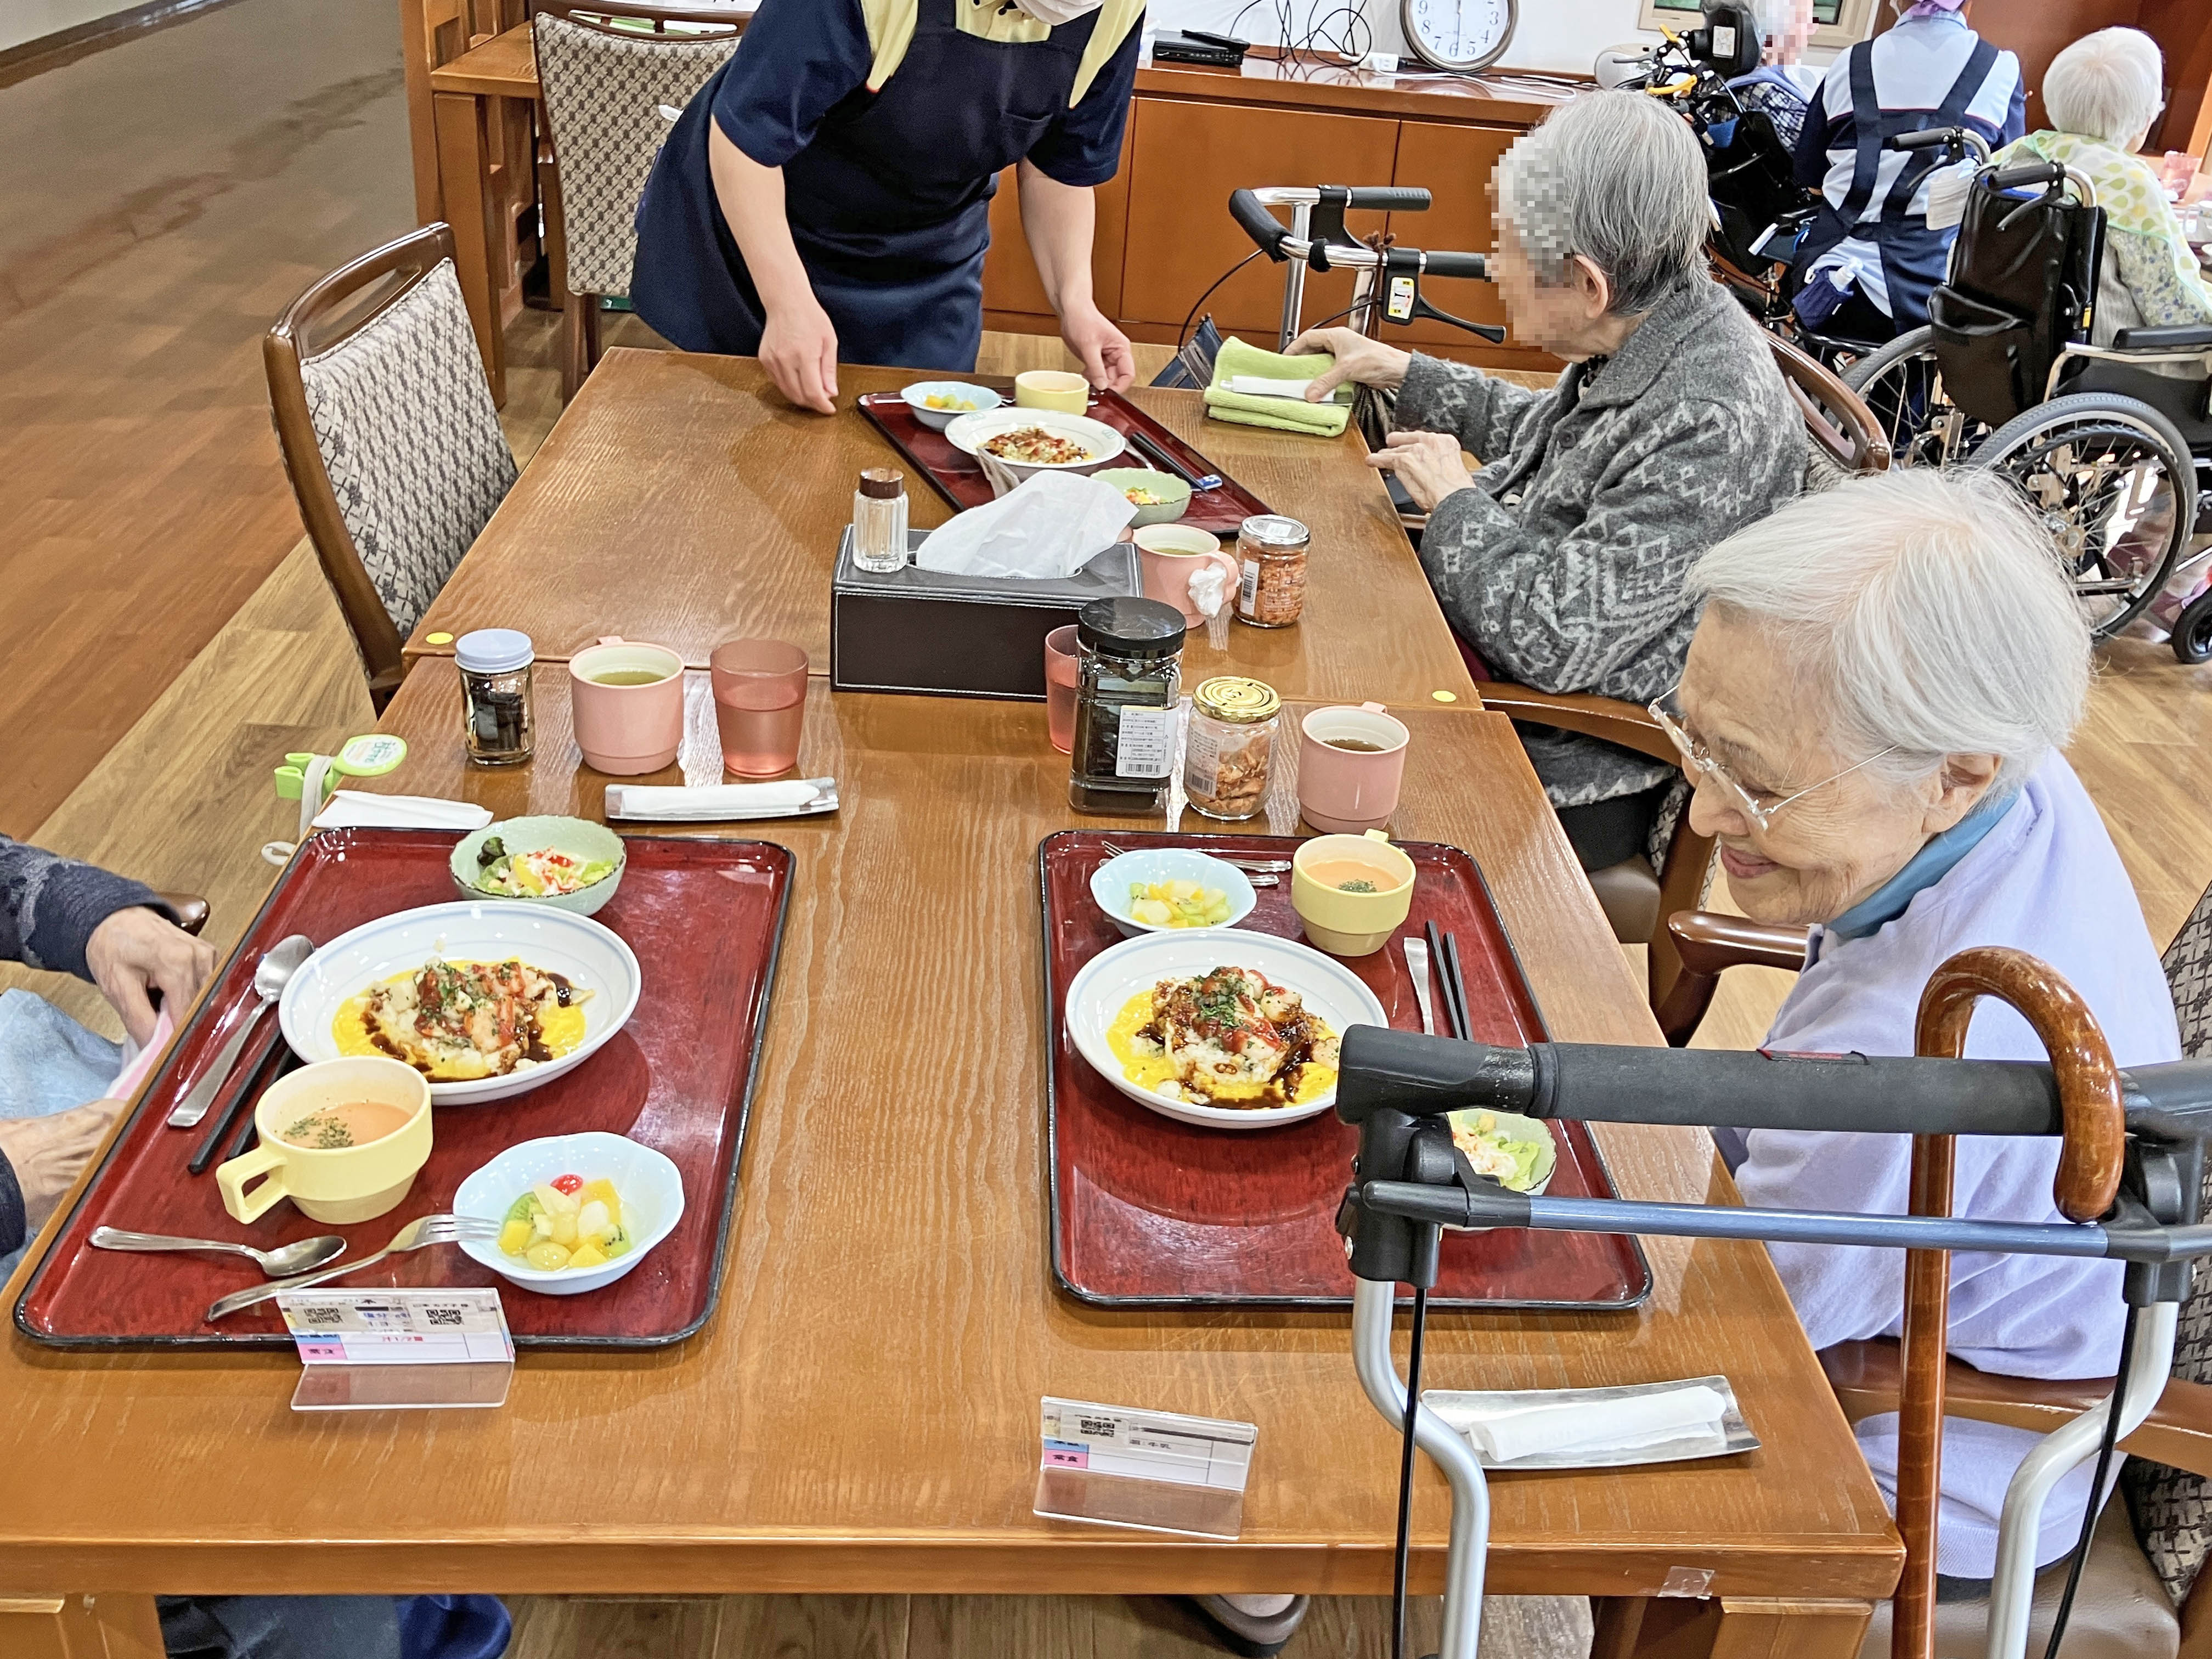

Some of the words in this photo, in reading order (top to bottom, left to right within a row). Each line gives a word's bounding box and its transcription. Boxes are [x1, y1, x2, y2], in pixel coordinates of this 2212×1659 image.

[1418, 0, 1427, 14] 9
[1489, 11, 1499, 25] 3
[1421, 19, 1431, 34] 8
[1435, 36, 1442, 50] 7
[1480, 30, 1489, 43] 4
[1449, 42, 1459, 57] 6
[1466, 41, 1476, 55] 5
